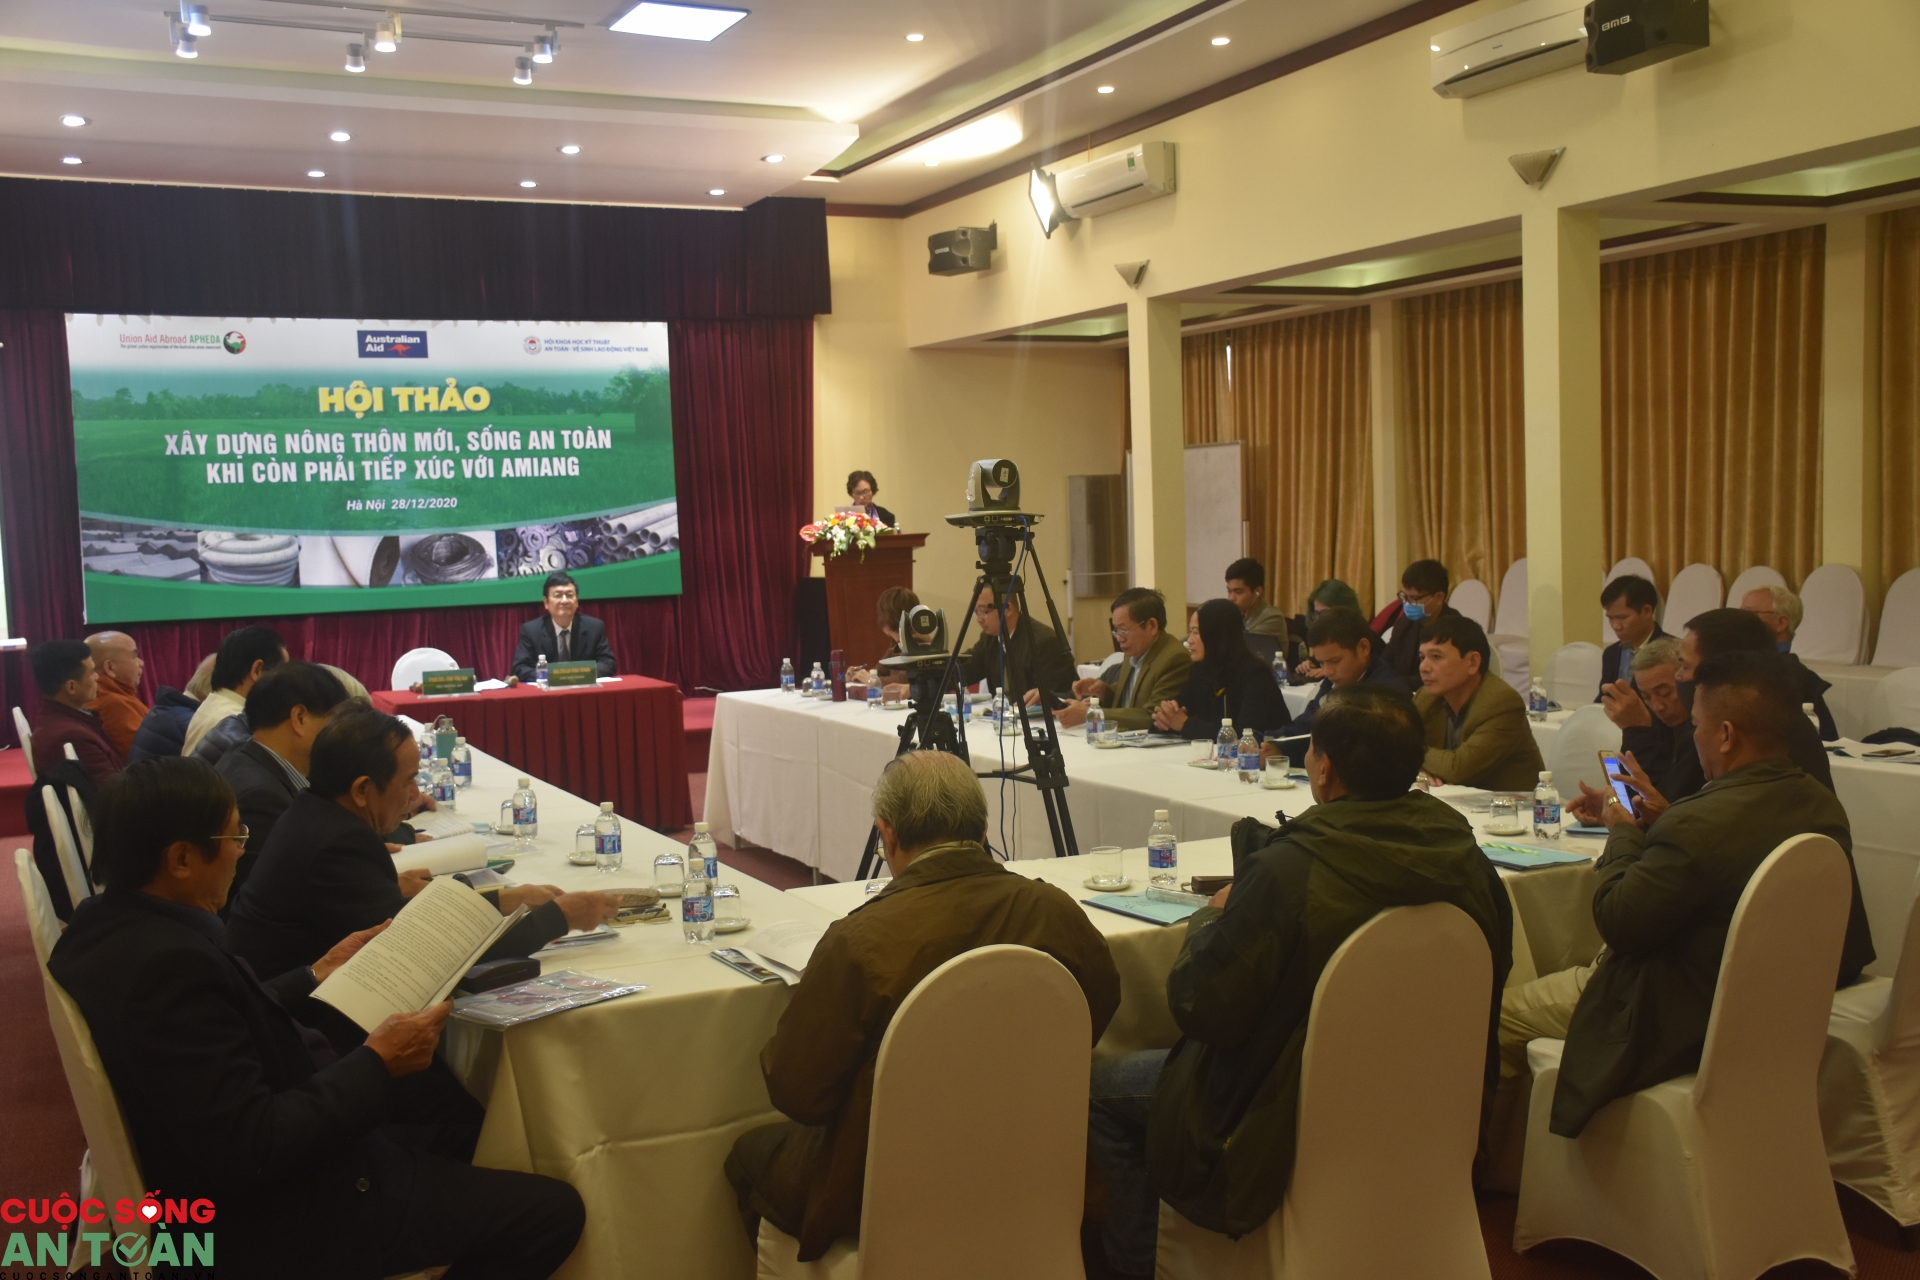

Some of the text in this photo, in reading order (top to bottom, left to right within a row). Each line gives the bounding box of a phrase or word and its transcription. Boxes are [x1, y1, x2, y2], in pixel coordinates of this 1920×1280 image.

[120, 334, 221, 344] Union Aid Abroad APHEDA
[365, 335, 420, 343] Australian
[366, 344, 384, 352] Aid
[319, 378, 491, 419] HỘI THẢO
[164, 424, 611, 459] XÂY DỰNG NÔNG THÔN MỚI, SỐNG AN TOÀN
[206, 454, 580, 484] KHI CÒN PHẢI TIẾP XÚC VỚI AMIANG
[346, 497, 457, 512] Hà Nội 28/12/2020
